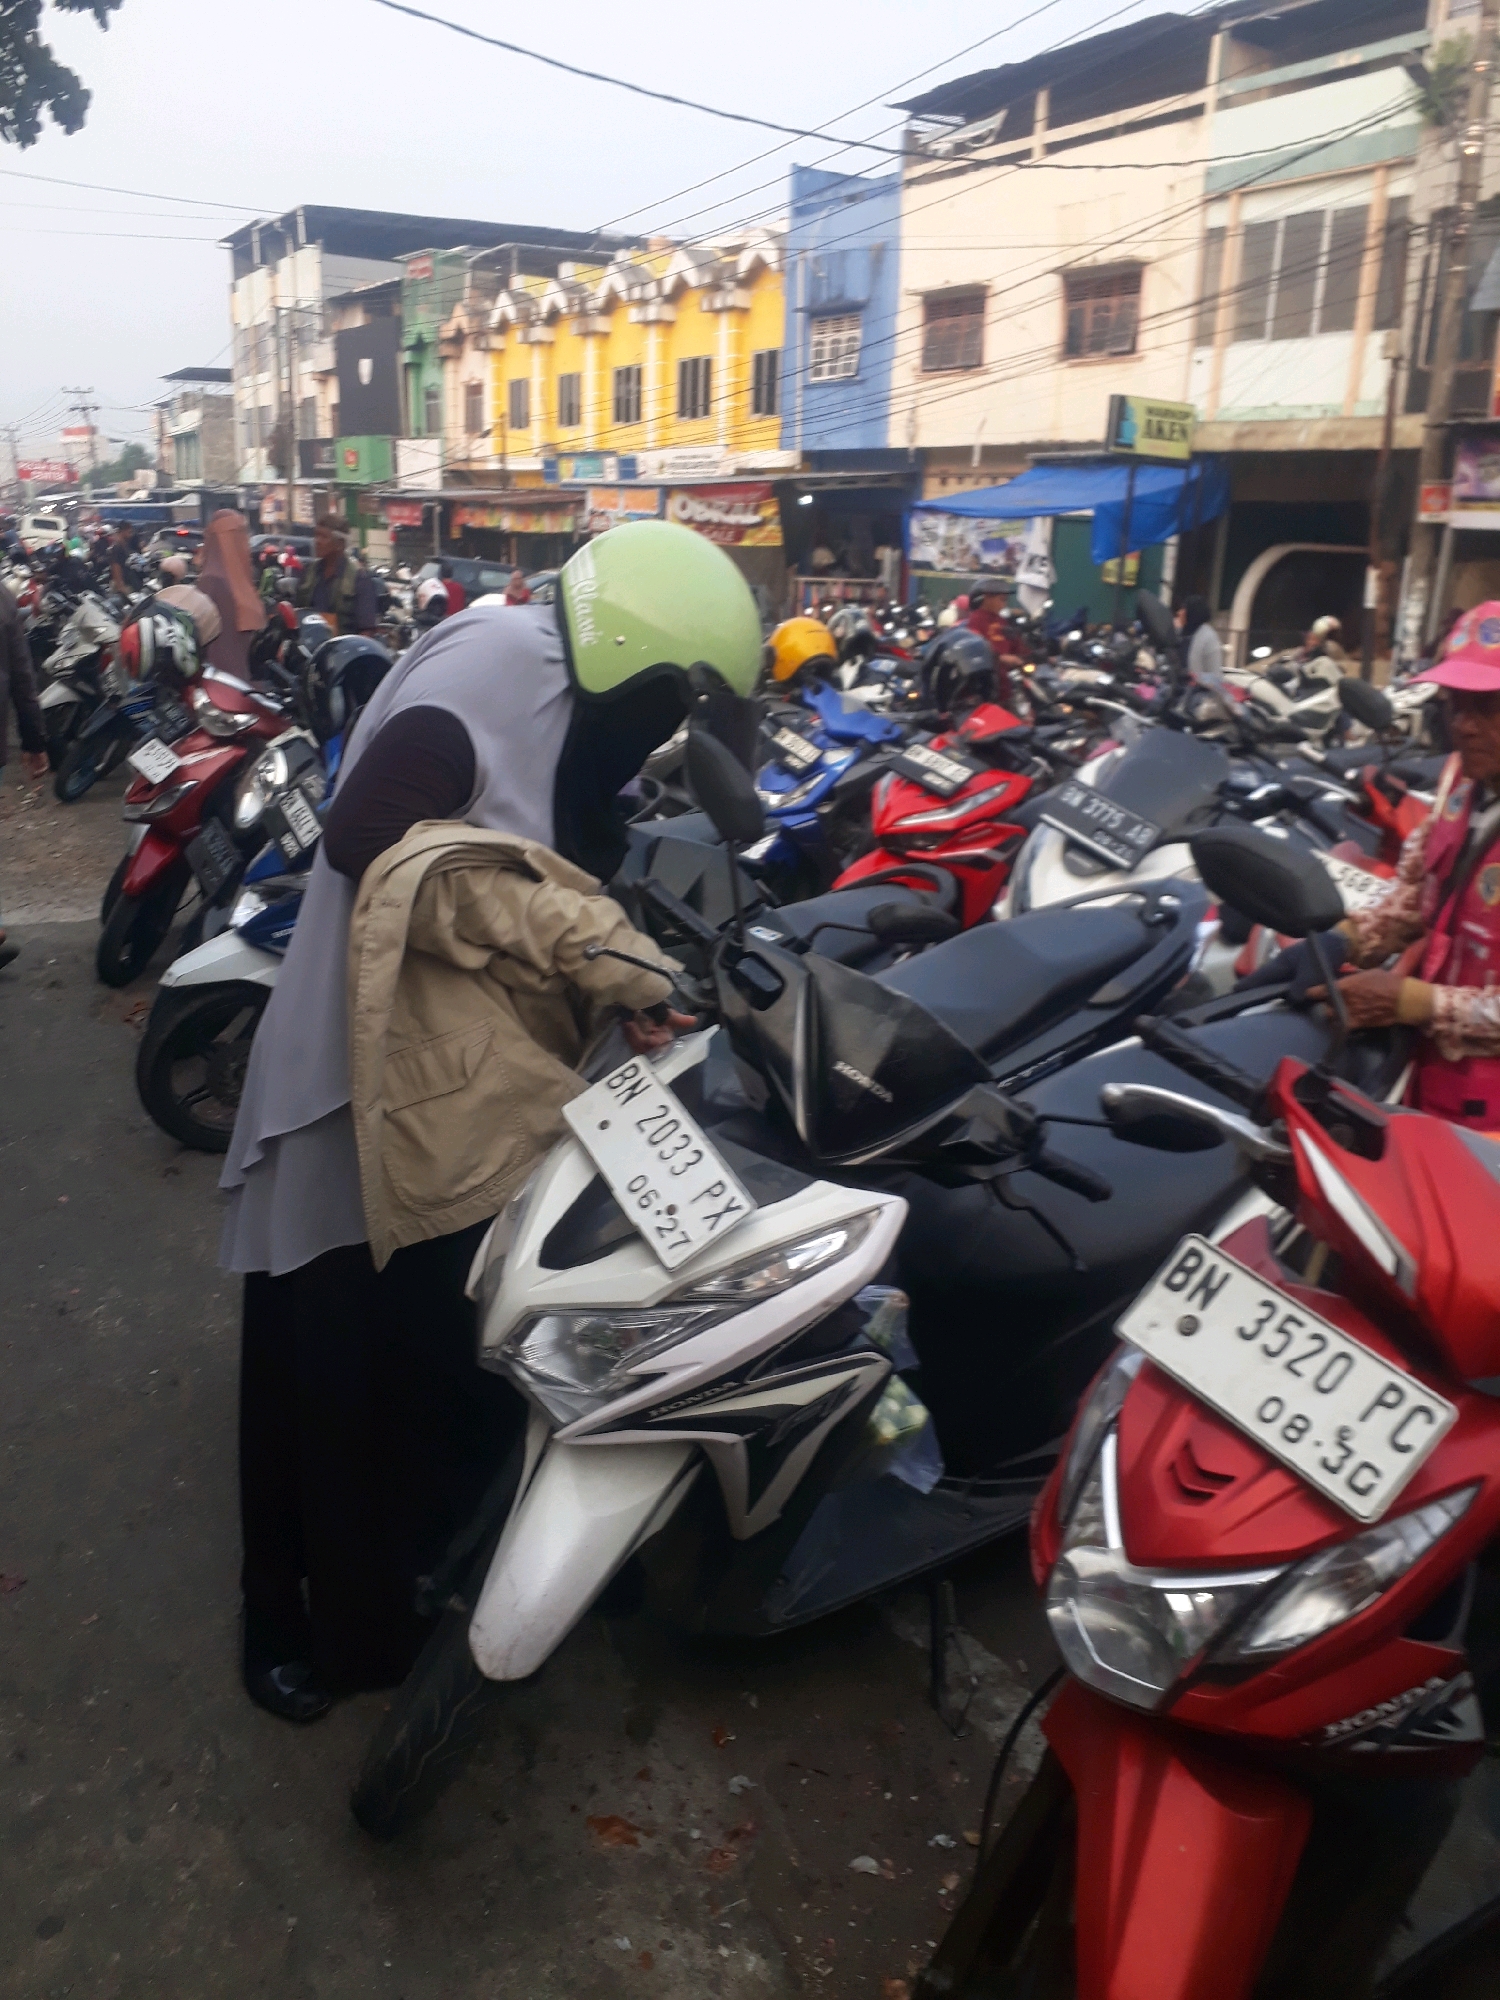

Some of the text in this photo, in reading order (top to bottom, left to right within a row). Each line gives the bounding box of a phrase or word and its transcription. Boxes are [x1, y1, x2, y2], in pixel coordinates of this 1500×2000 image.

[1081, 797, 1126, 829] 3775
[607, 1062, 744, 1232] BN 2033 PX
[1163, 1246, 1438, 1455] BN 3520 PC
[648, 1381, 741, 1417] HONDA
[1324, 1676, 1448, 1738] HONDA
